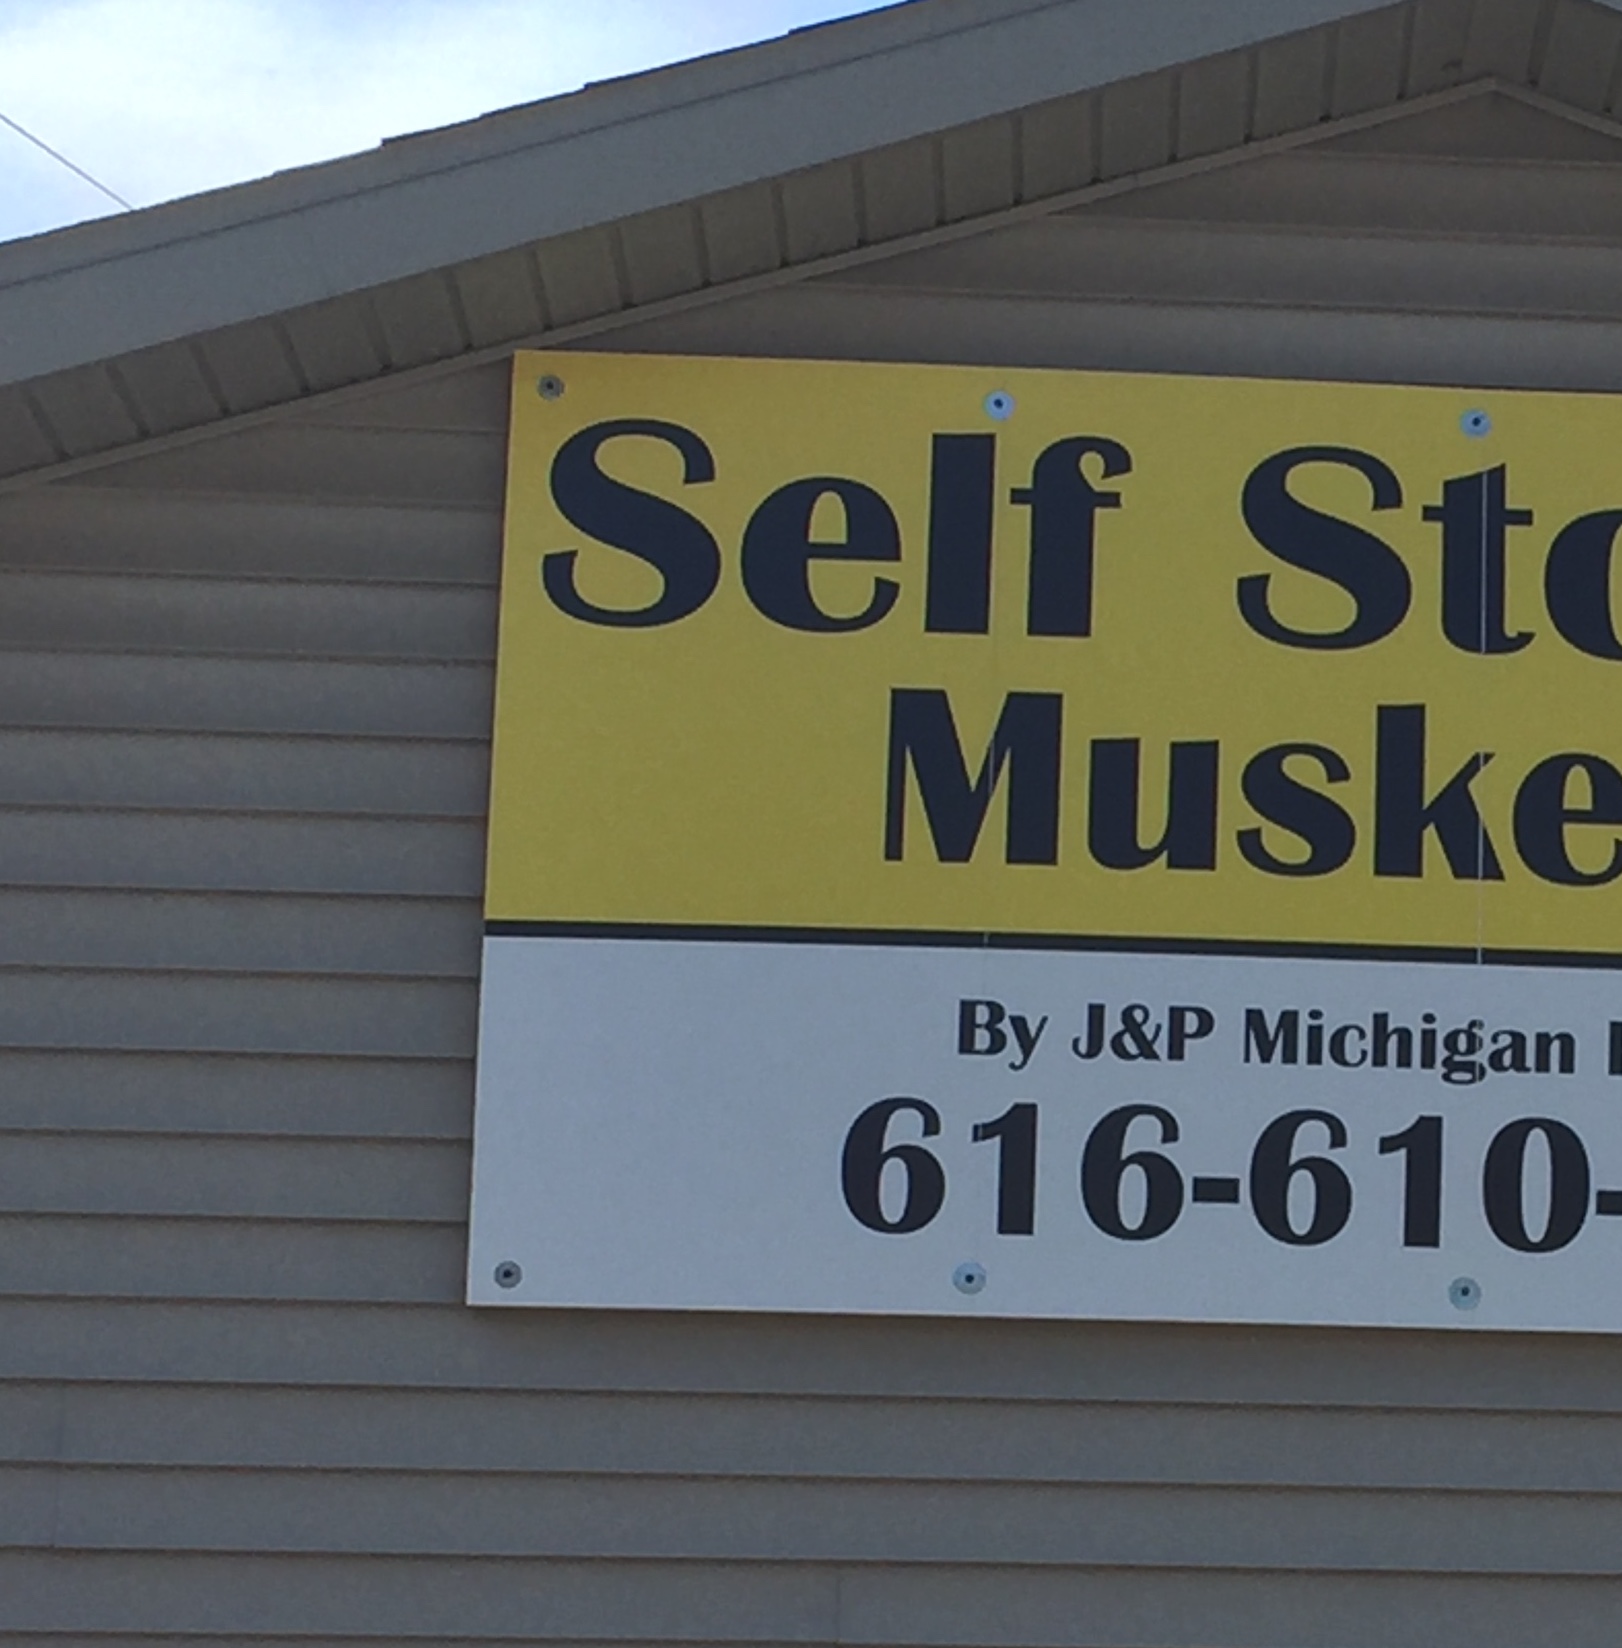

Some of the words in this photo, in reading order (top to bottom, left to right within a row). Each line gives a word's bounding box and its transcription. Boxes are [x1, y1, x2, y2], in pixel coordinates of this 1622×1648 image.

[541, 418, 1133, 639] Self
[957, 999, 1048, 1071] By
[1072, 1003, 1215, 1062] J&P
[1243, 1008, 1578, 1085] Michigan
